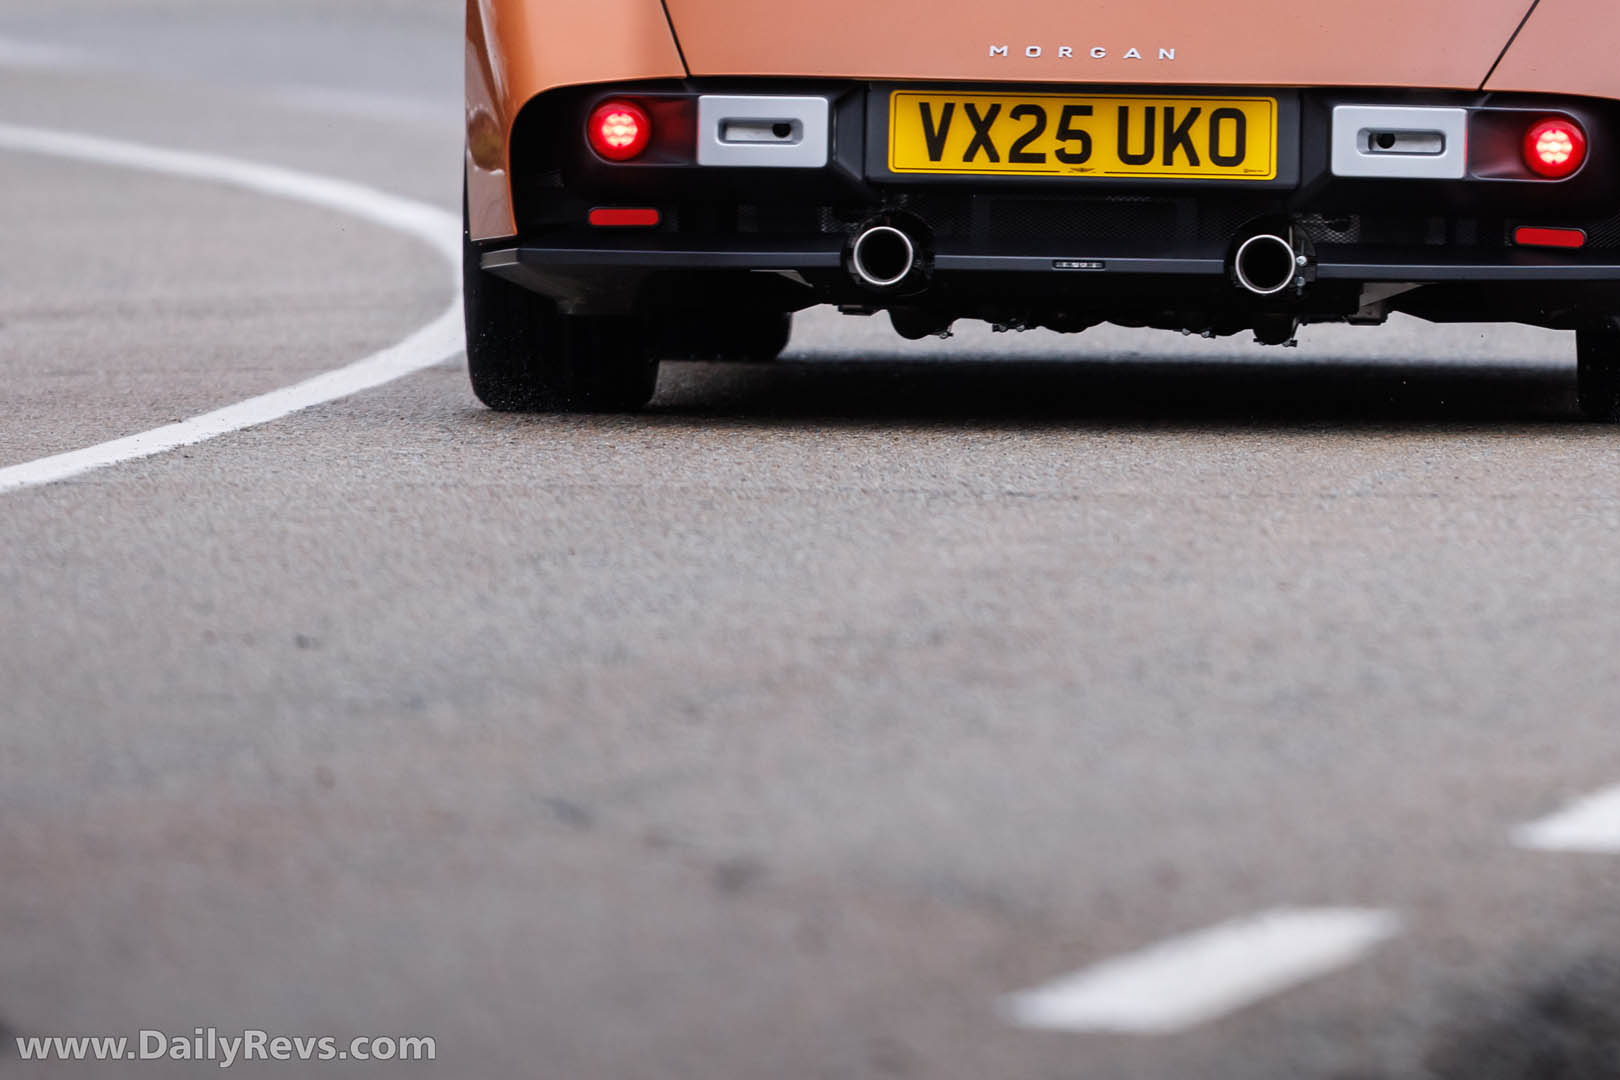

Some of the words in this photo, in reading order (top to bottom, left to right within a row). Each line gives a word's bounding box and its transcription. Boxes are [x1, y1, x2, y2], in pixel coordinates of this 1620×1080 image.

[989, 44, 1175, 60] MORGAN
[918, 101, 1094, 165] VX25
[1117, 105, 1247, 168] UKO
